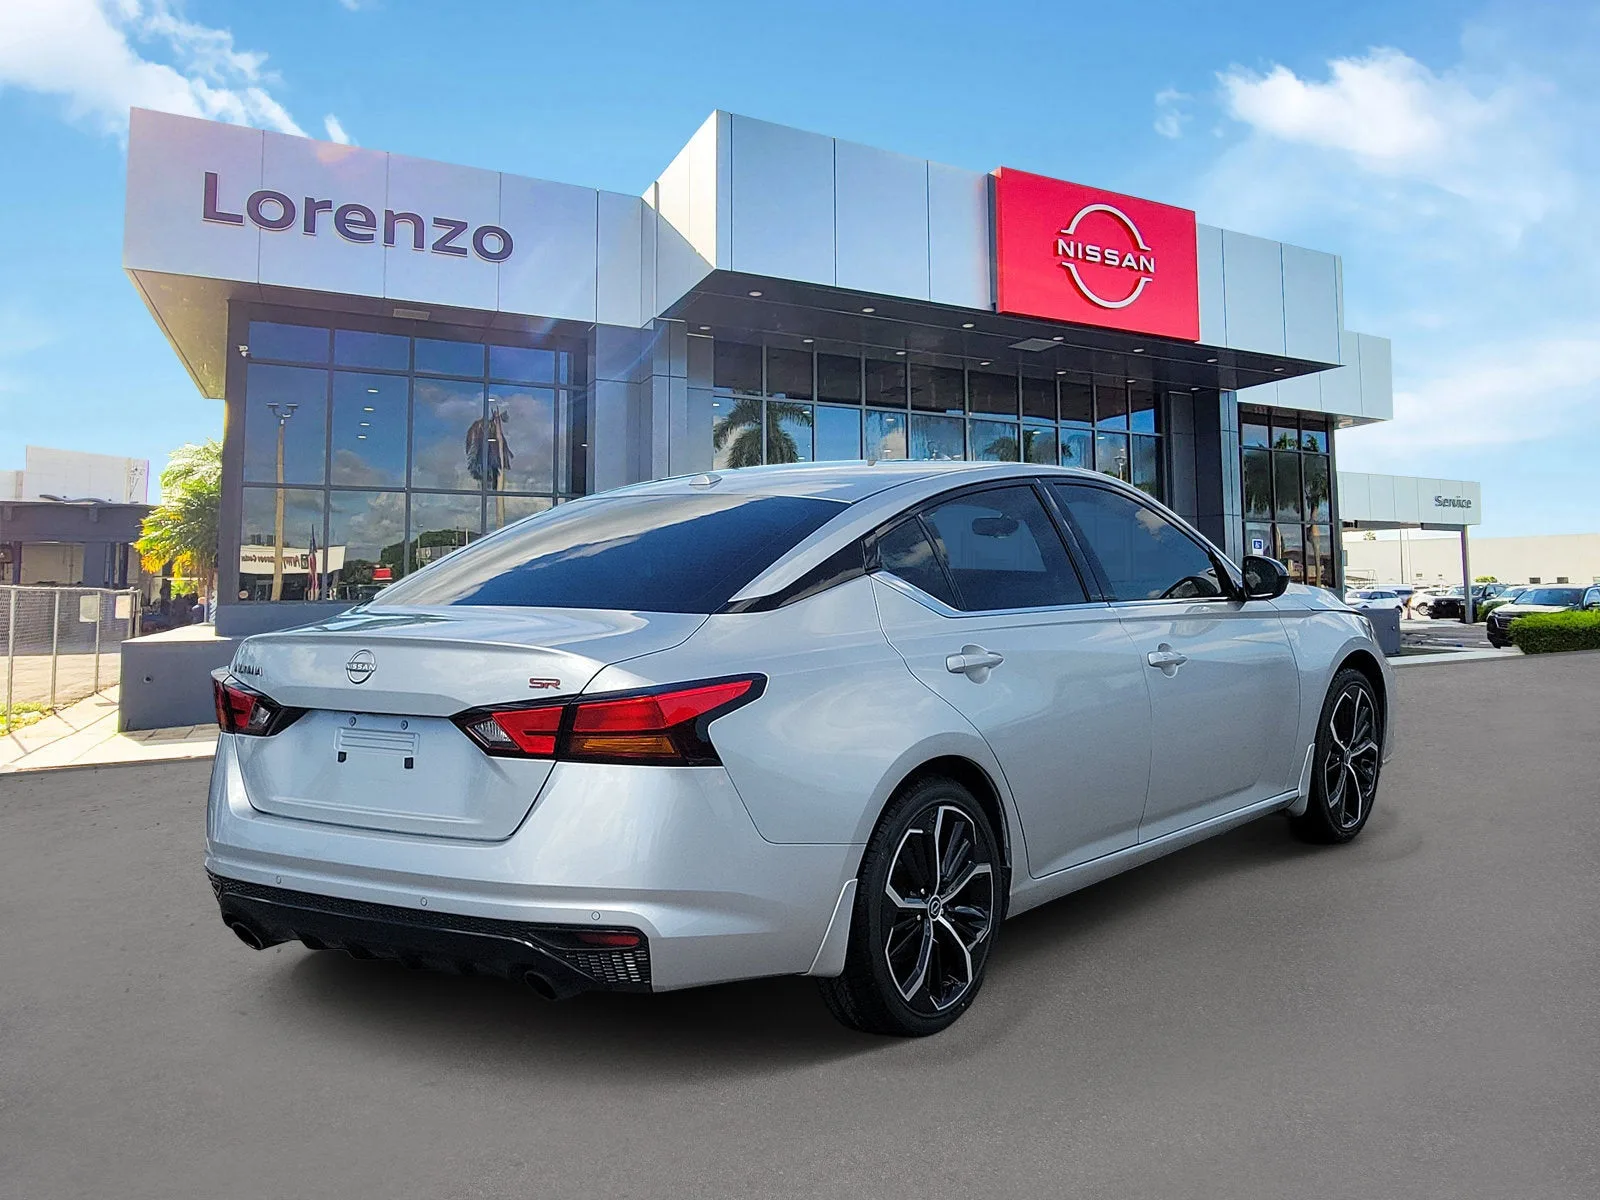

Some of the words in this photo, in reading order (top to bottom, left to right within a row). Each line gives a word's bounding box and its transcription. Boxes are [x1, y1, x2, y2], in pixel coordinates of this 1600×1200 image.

[202, 171, 514, 263] Lorenzo
[1056, 238, 1156, 273] NISSAN
[1434, 495, 1472, 508] Service
[346, 661, 377, 672] NISSAN
[529, 677, 561, 690] SR
